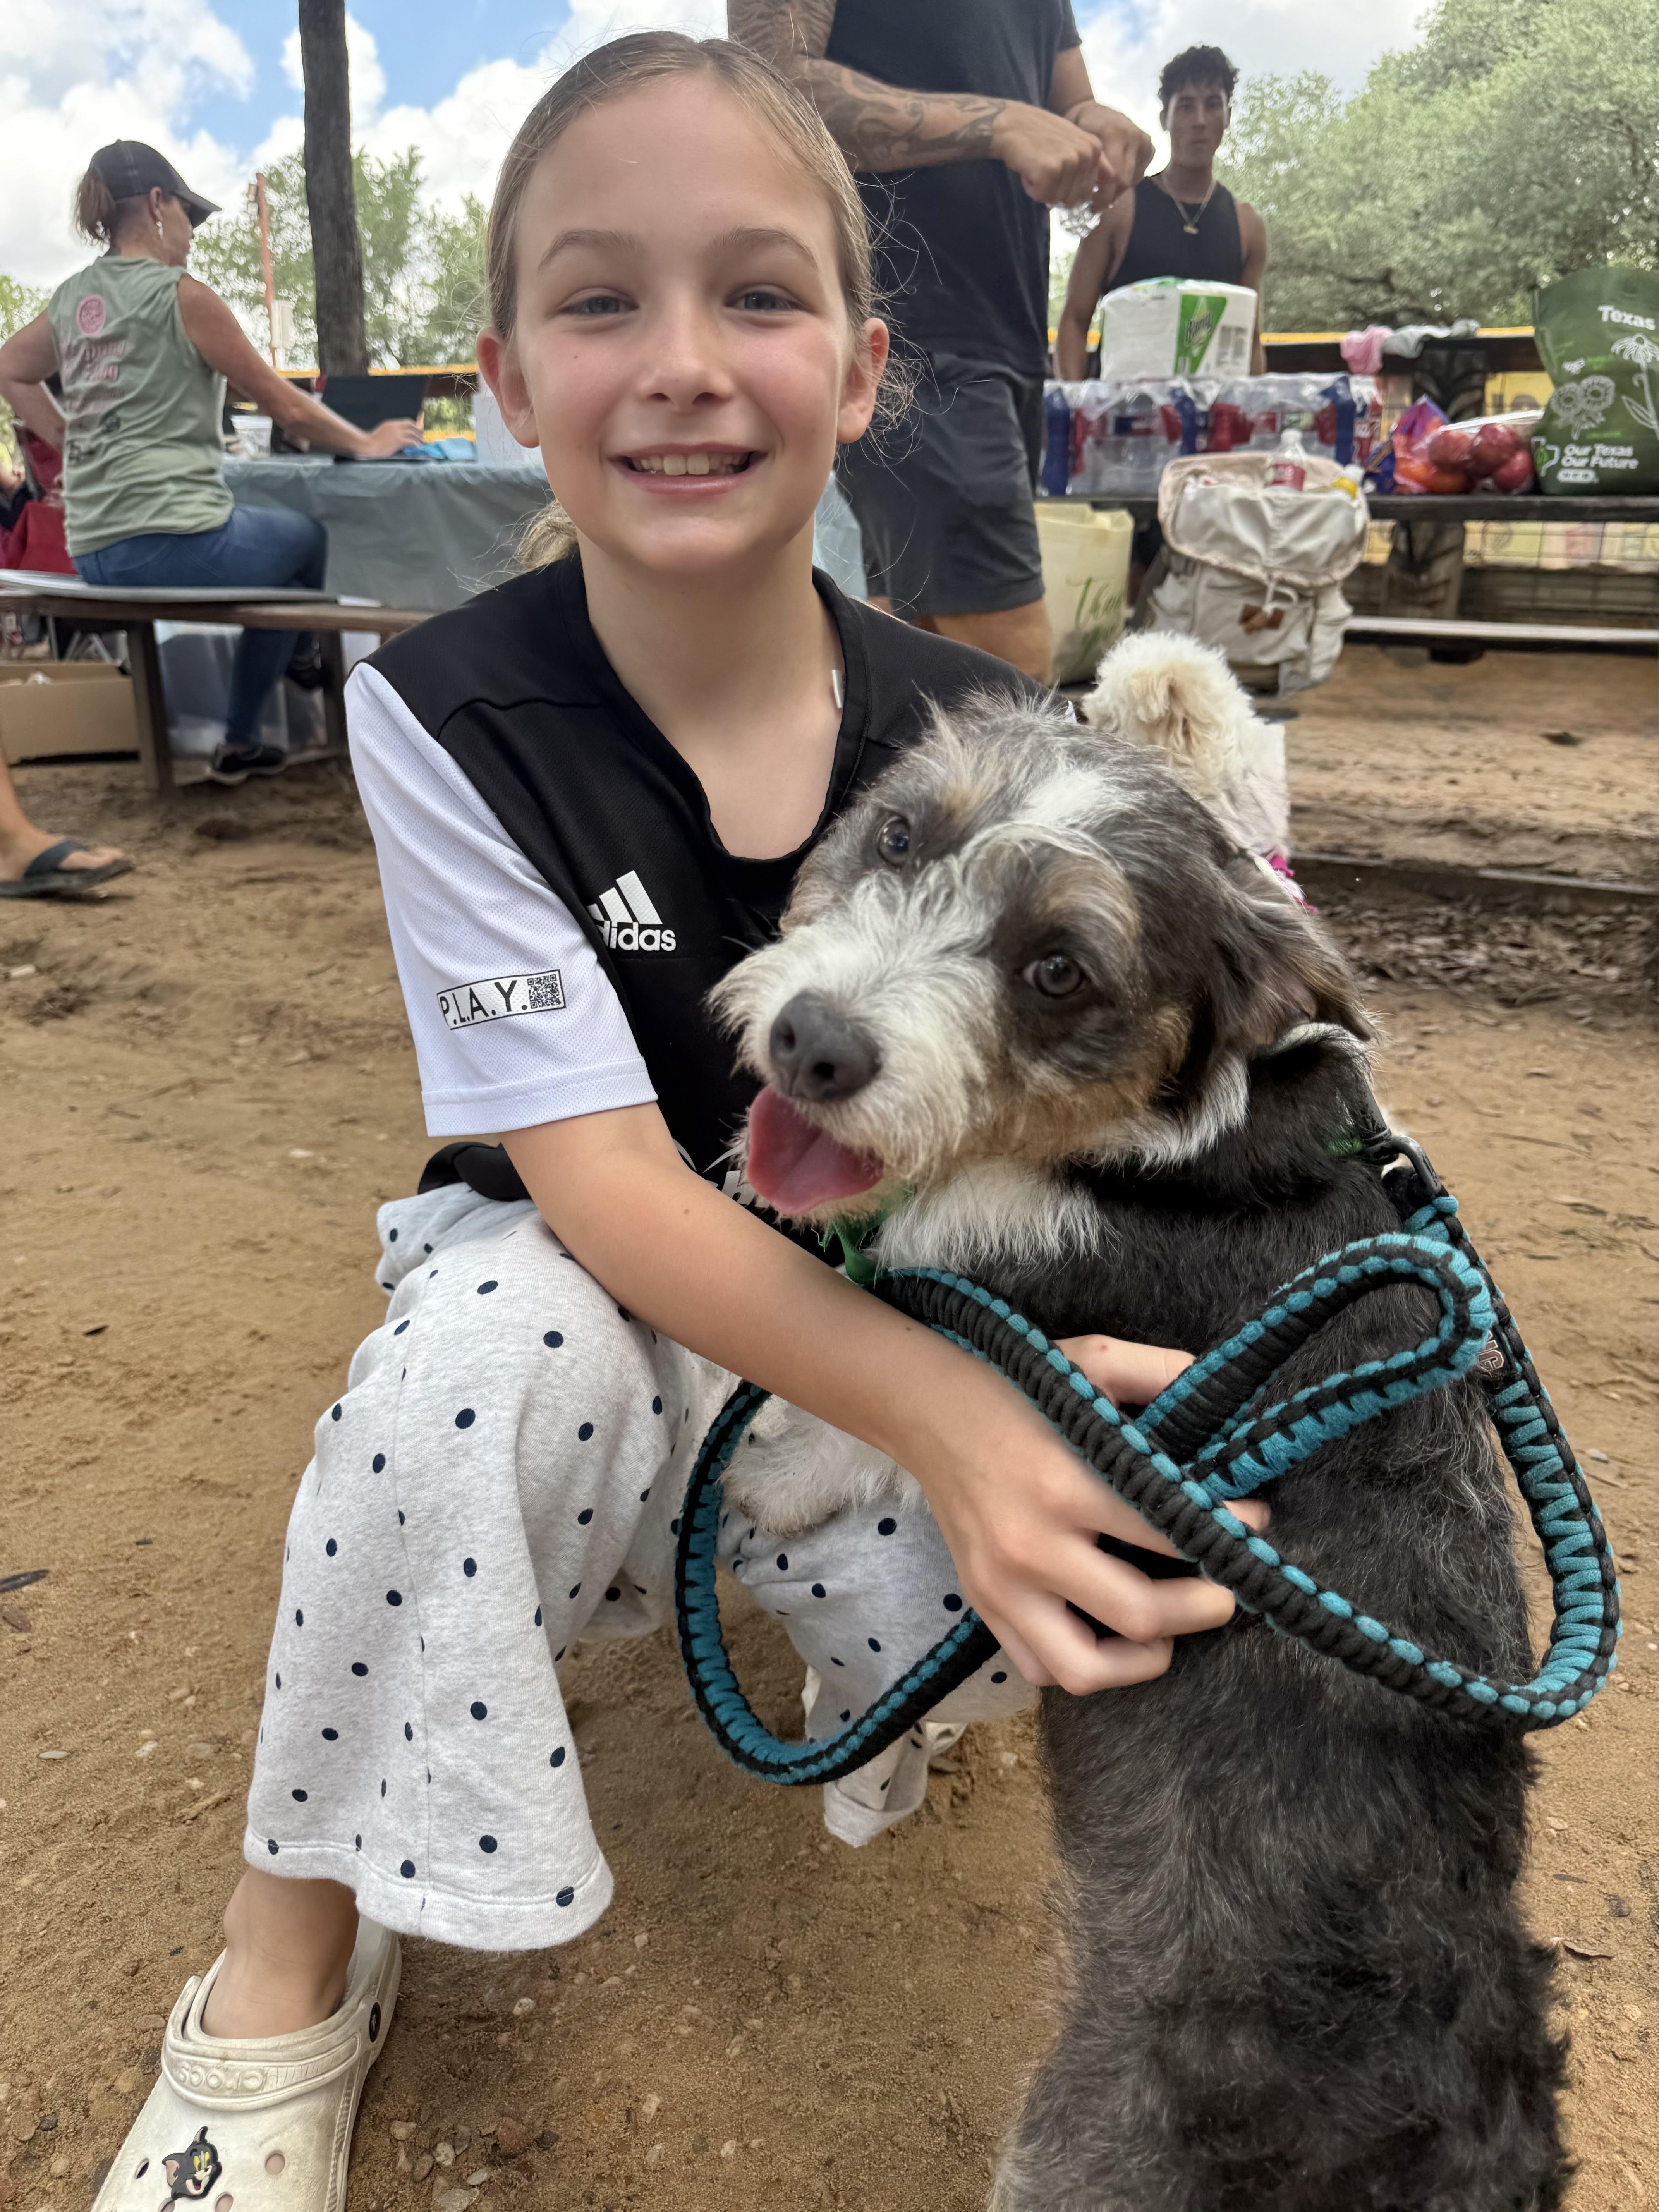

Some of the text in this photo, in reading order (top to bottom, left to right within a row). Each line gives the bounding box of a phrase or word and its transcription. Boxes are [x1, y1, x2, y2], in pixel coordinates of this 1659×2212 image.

[1598, 305, 1656, 330] Texas
[1564, 444, 1633, 457] Our Texas
[1561, 455, 1639, 469] Our Future
